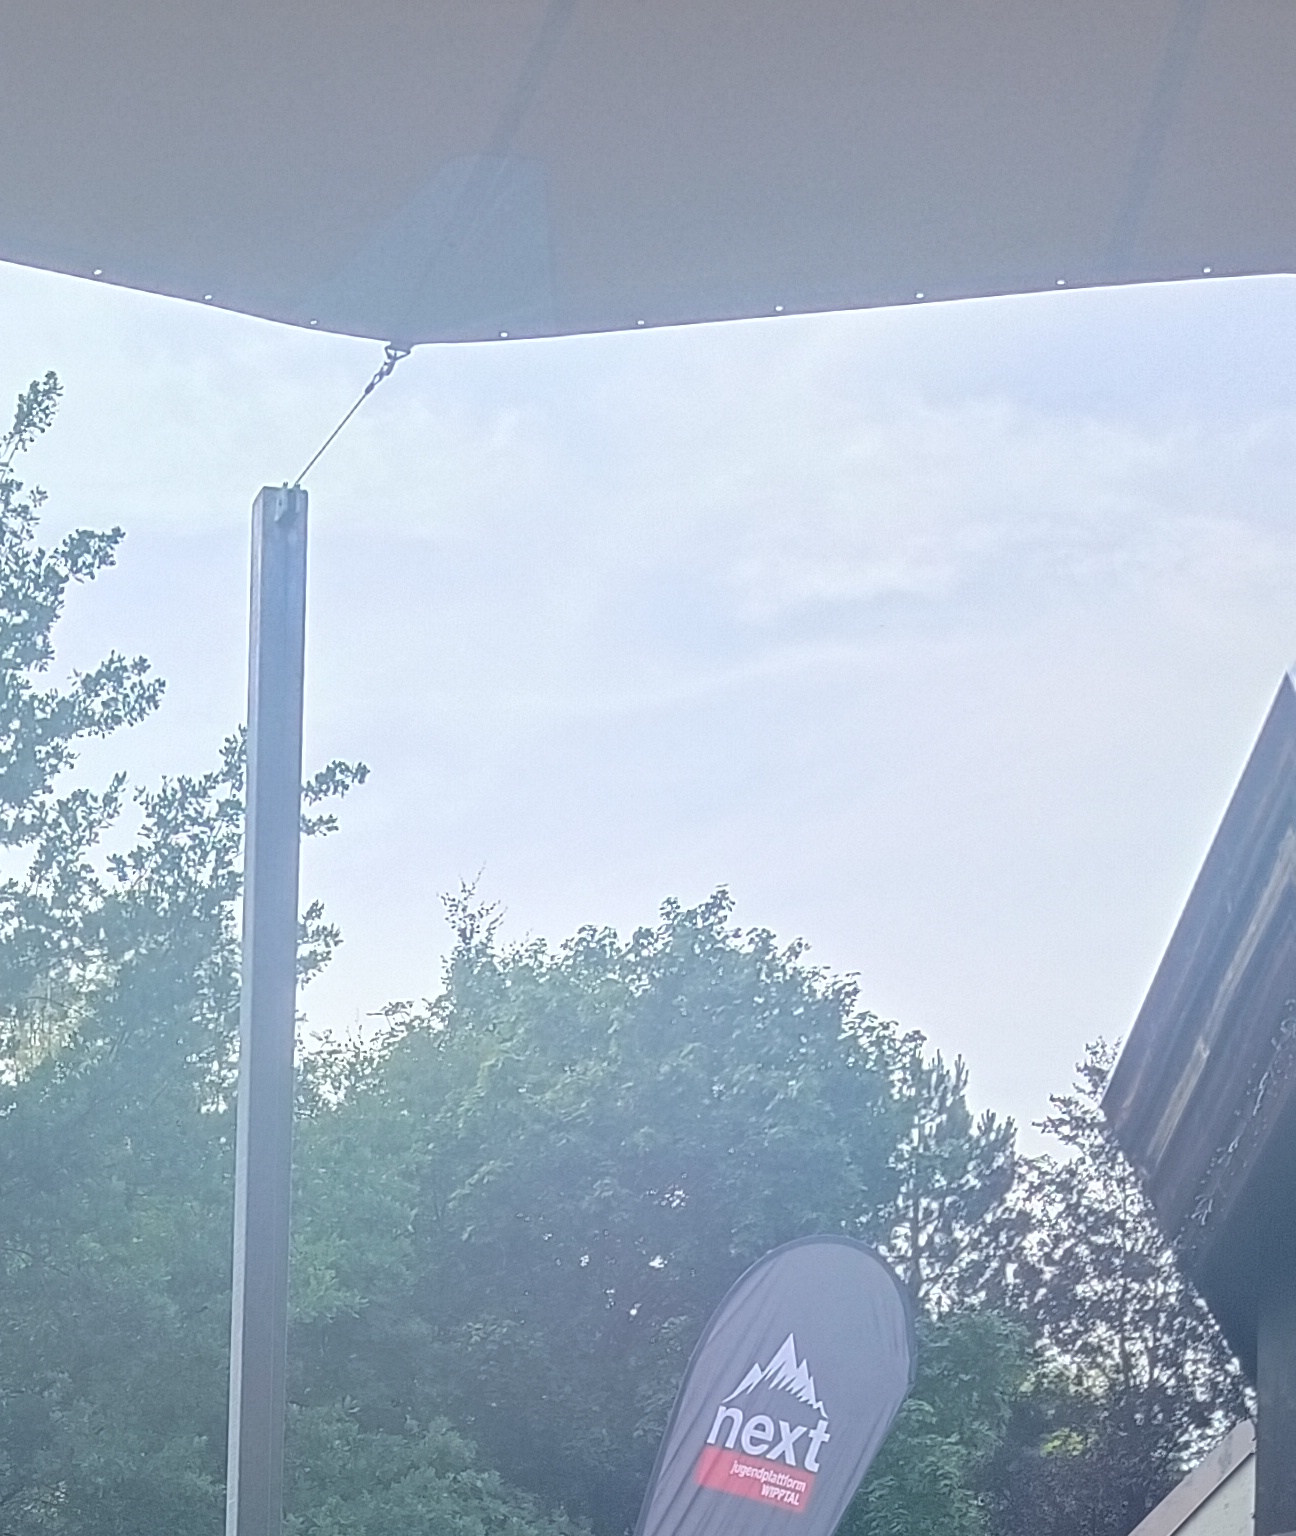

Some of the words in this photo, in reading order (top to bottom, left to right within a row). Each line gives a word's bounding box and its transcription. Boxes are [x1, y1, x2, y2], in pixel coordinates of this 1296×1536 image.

[706, 1405, 831, 1473] next
[730, 1460, 806, 1492] jugendplattform
[761, 1483, 800, 1506] WIPPTAL
